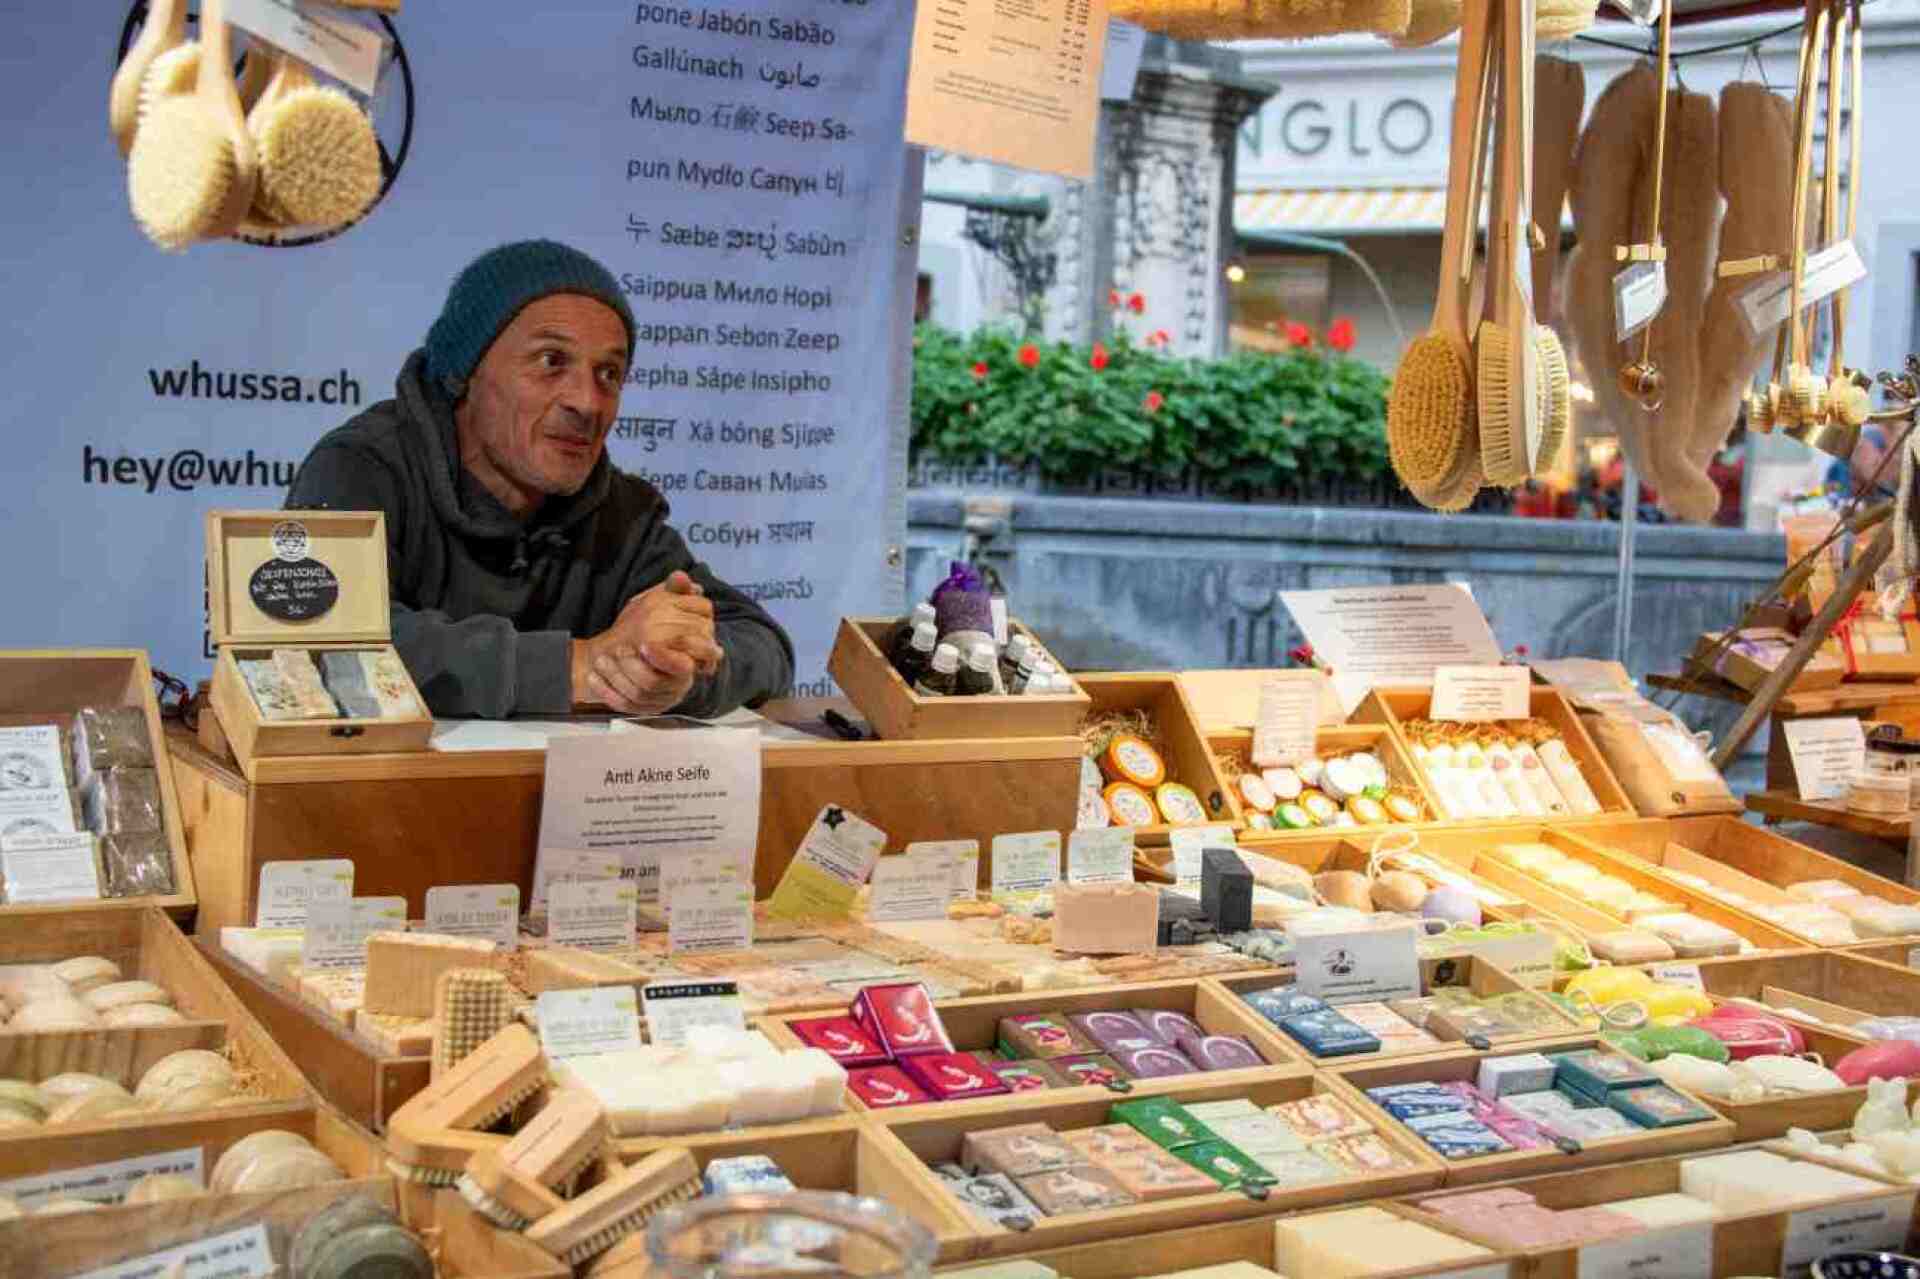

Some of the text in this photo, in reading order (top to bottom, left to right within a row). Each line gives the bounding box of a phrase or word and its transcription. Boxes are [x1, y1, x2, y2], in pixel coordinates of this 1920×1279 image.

[635, 3, 835, 45] pone Jabón Sabão
[632, 45, 744, 79] Gallúnach
[631, 97, 701, 126] Мыло
[765, 112, 816, 141] Seep
[627, 158, 670, 181] pun
[661, 221, 719, 249] Sæbe
[620, 272, 706, 303] Saippua
[716, 323, 779, 350] Sebon
[784, 327, 841, 352] Zeep
[148, 360, 361, 406] whussa.ch
[751, 369, 831, 395] Insipho
[688, 521, 761, 549] Собун
[604, 765, 711, 785] Anti Akne Seife
